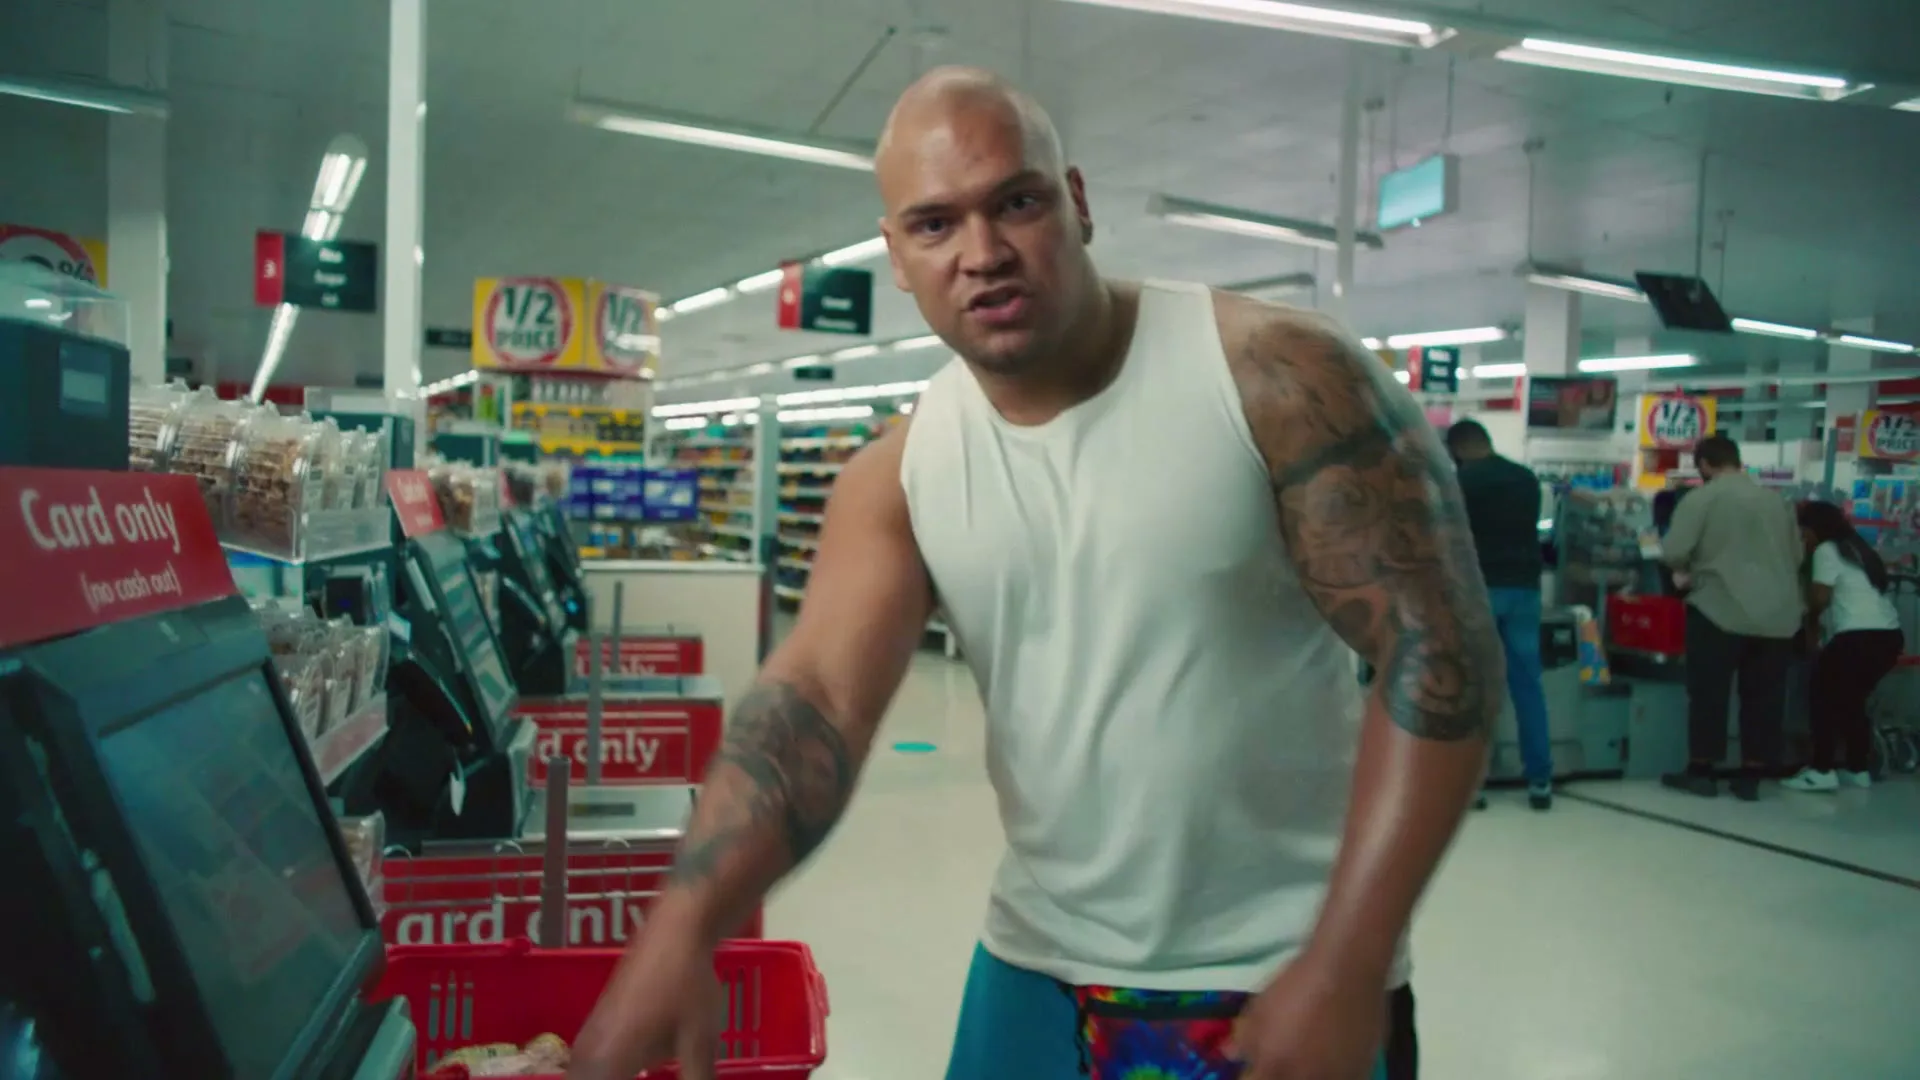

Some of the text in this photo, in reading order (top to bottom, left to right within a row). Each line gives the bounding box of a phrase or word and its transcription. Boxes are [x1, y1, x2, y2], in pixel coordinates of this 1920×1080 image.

[503, 286, 553, 325] 1/2
[496, 330, 555, 349] PRICE
[1656, 424, 1698, 440] PRICE
[1662, 401, 1698, 427] 1/2
[20, 484, 181, 554] Card only
[80, 559, 183, 614] (no cash out)
[392, 893, 506, 946] ard
